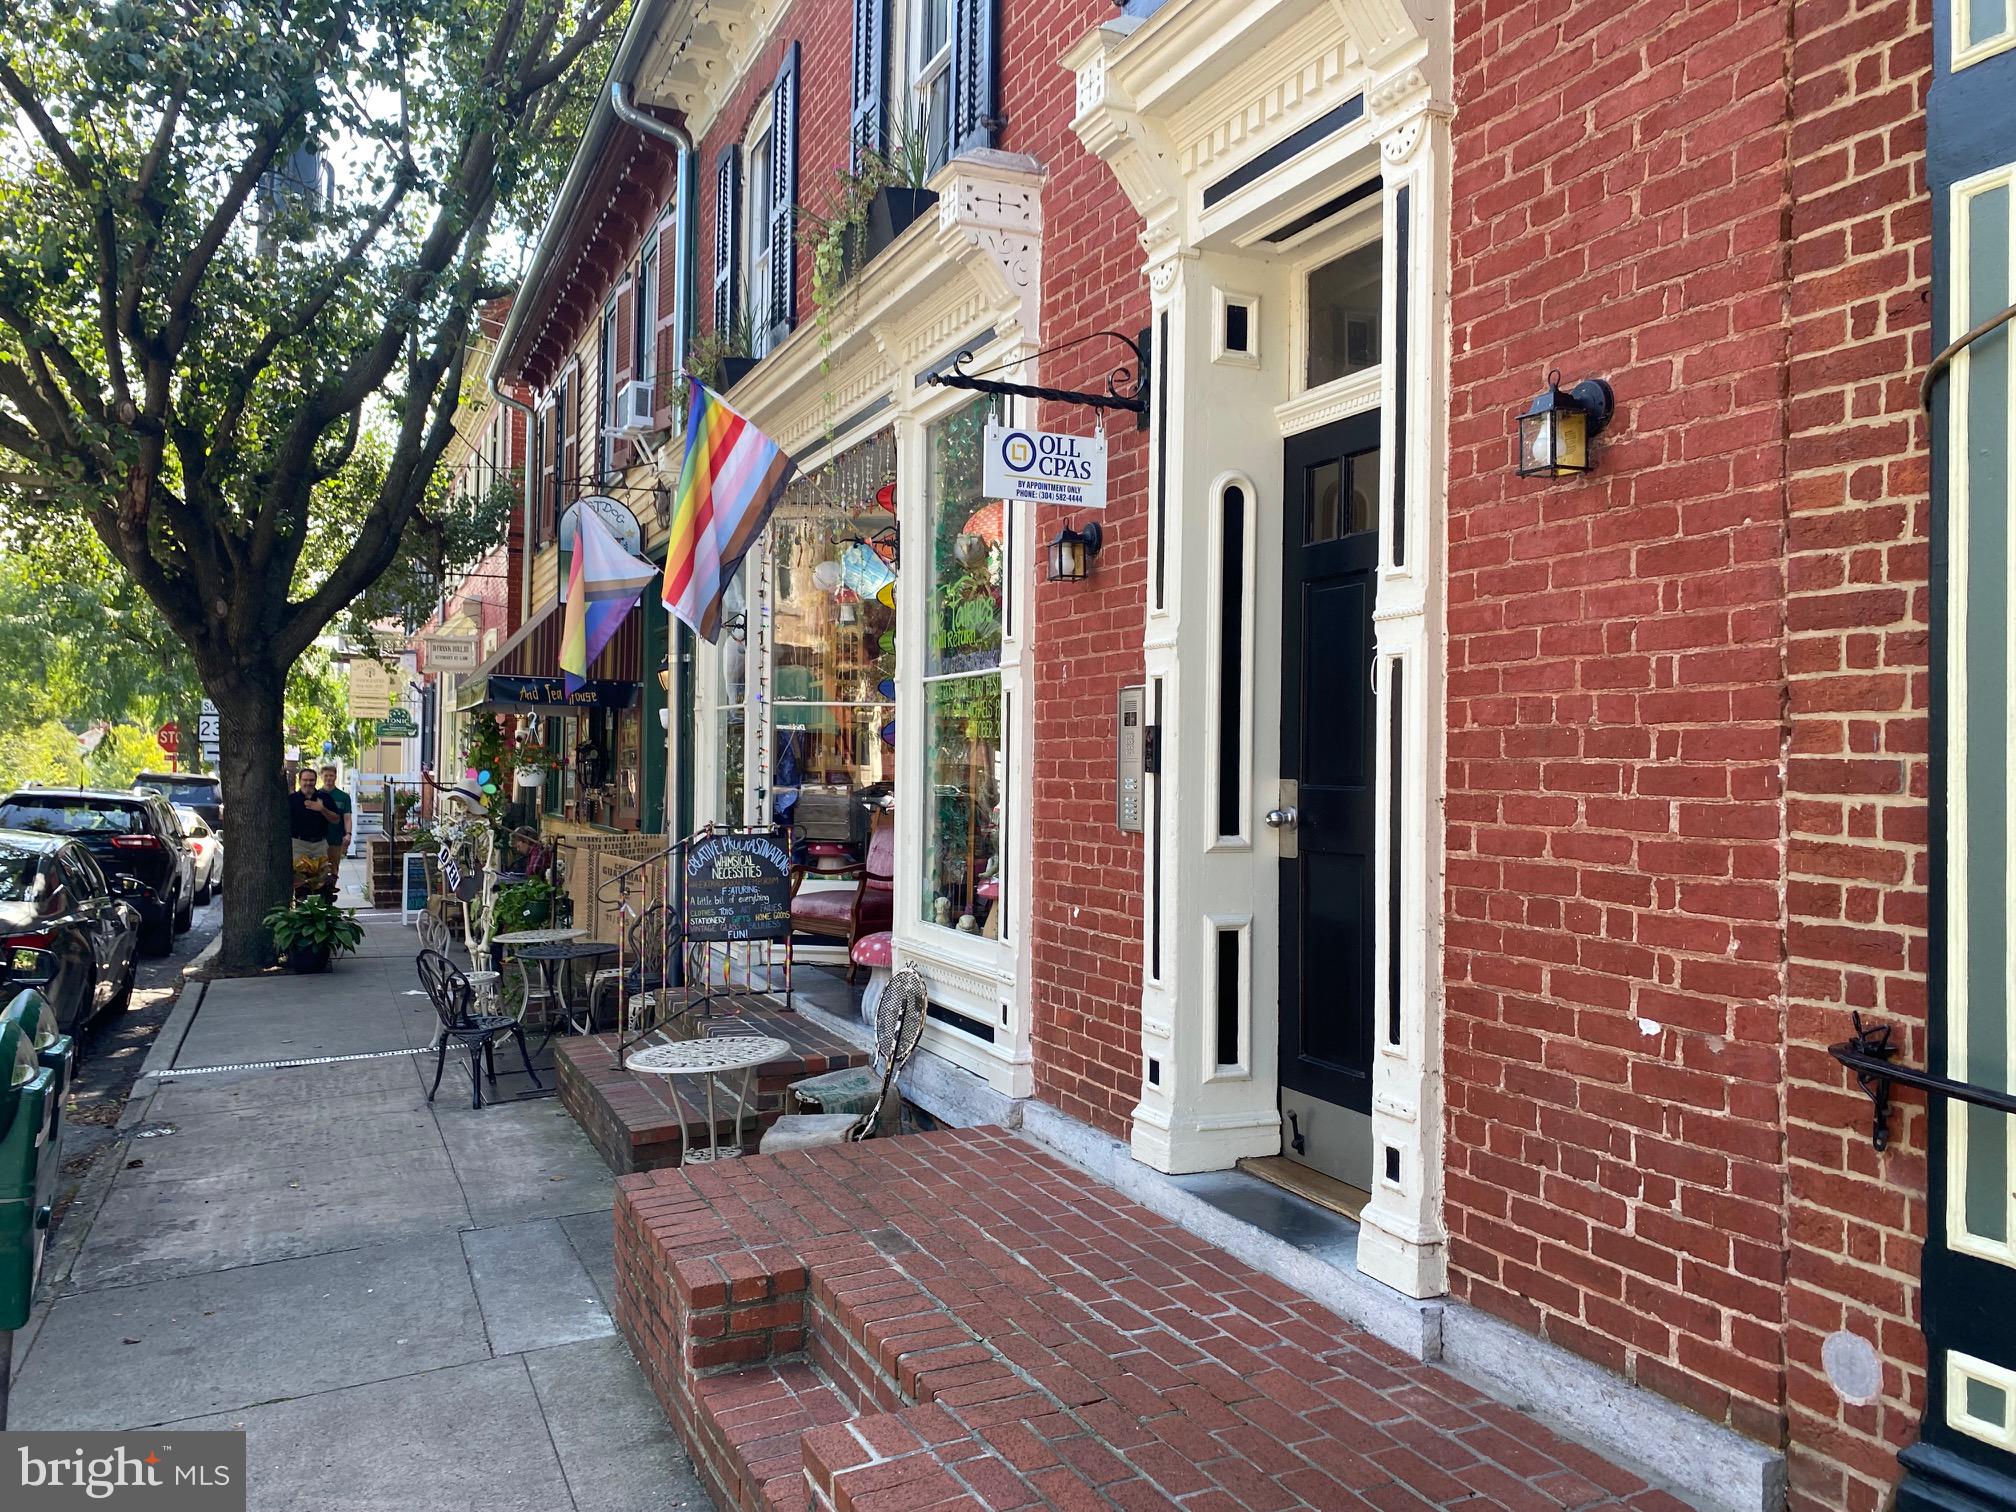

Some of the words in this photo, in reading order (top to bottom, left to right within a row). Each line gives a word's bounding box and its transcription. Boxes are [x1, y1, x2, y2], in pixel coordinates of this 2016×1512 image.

[1039, 435, 1081, 458] OLL
[1038, 456, 1091, 480] CPAS
[1018, 480, 1026, 488] BY
[1026, 481, 1067, 493] APPOINTMENT
[1067, 485, 1082, 494] ONLY
[1016, 489, 1038, 499] PHONE:
[1039, 490, 1055, 501] (304)
[1056, 493, 1083, 503] 582-4444
[602, 501, 625, 524] DOG
[520, 685, 539, 701] And
[544, 683, 562, 704] Tea
[160, 731, 180, 744] STO
[687, 838, 723, 876] CREATIVE
[714, 854, 755, 869] WHIMSICAL
[711, 865, 762, 880] NECESSITIES
[738, 892, 770, 904] everything
[754, 913, 771, 921] HOME
[727, 928, 748, 939] FUN!
